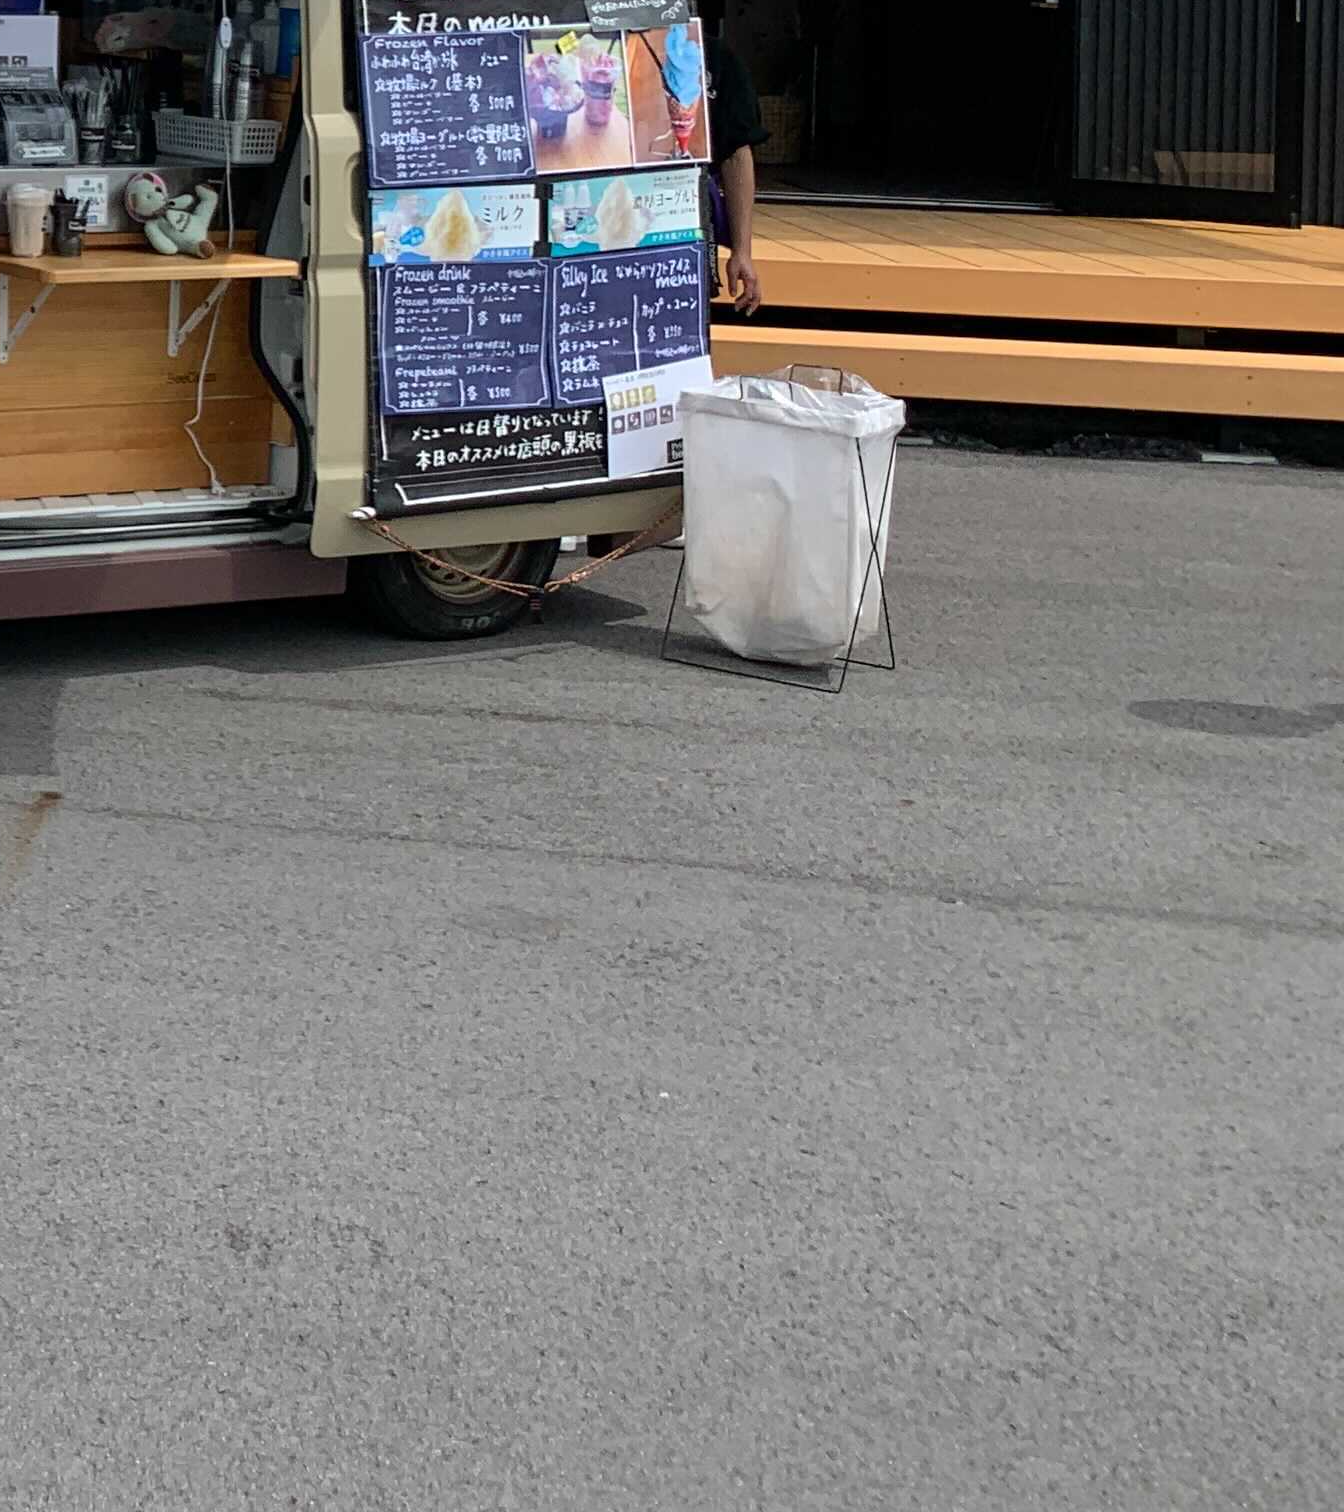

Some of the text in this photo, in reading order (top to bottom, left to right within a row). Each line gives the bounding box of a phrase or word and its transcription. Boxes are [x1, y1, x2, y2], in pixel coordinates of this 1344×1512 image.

[374, 37, 485, 50] Frozen Flavor
[479, 205, 525, 225] ミルク
[395, 263, 472, 282] Frozen drink
[591, 264, 609, 285] Ice
[655, 274, 699, 289] menu
[432, 294, 475, 305] smoothie
